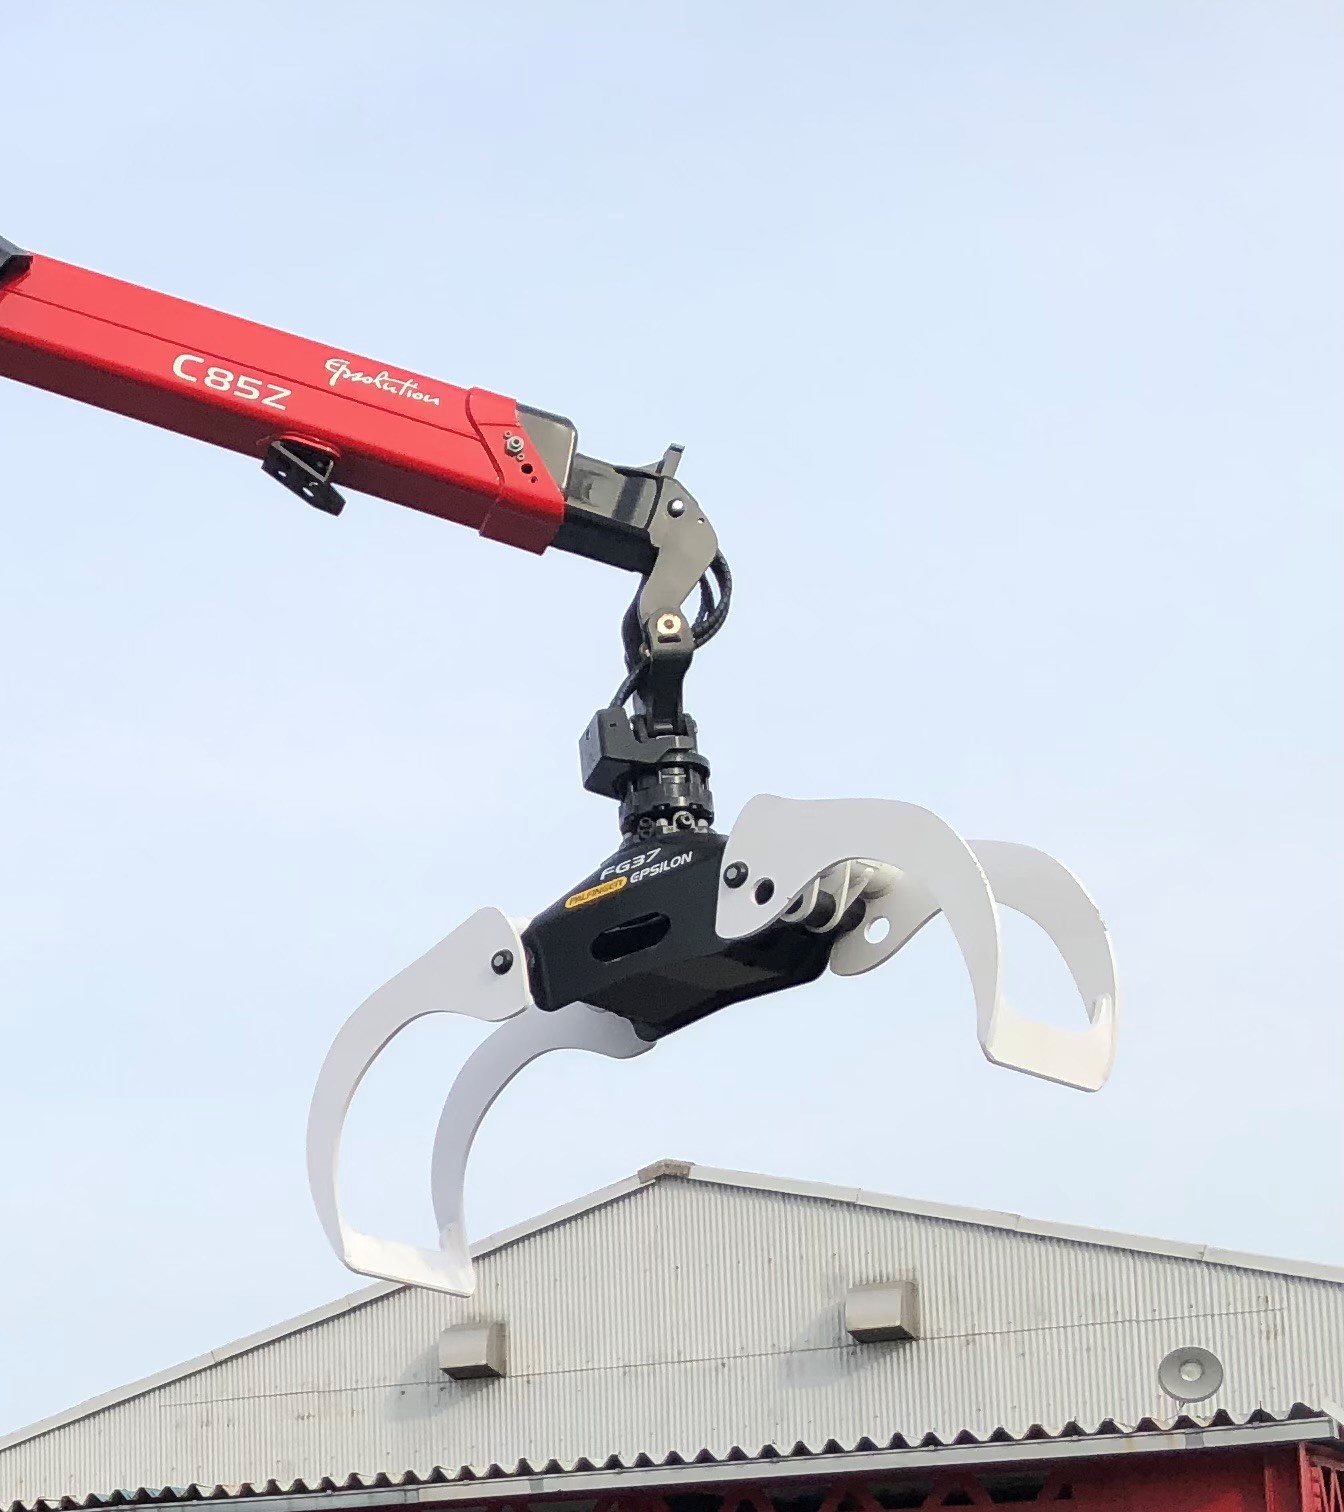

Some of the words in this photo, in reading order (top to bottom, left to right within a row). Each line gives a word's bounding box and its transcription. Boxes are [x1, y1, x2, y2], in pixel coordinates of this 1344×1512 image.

[324, 358, 440, 405] Epsolution
[599, 847, 662, 880] FG37
[629, 851, 693, 883] EPSILON
